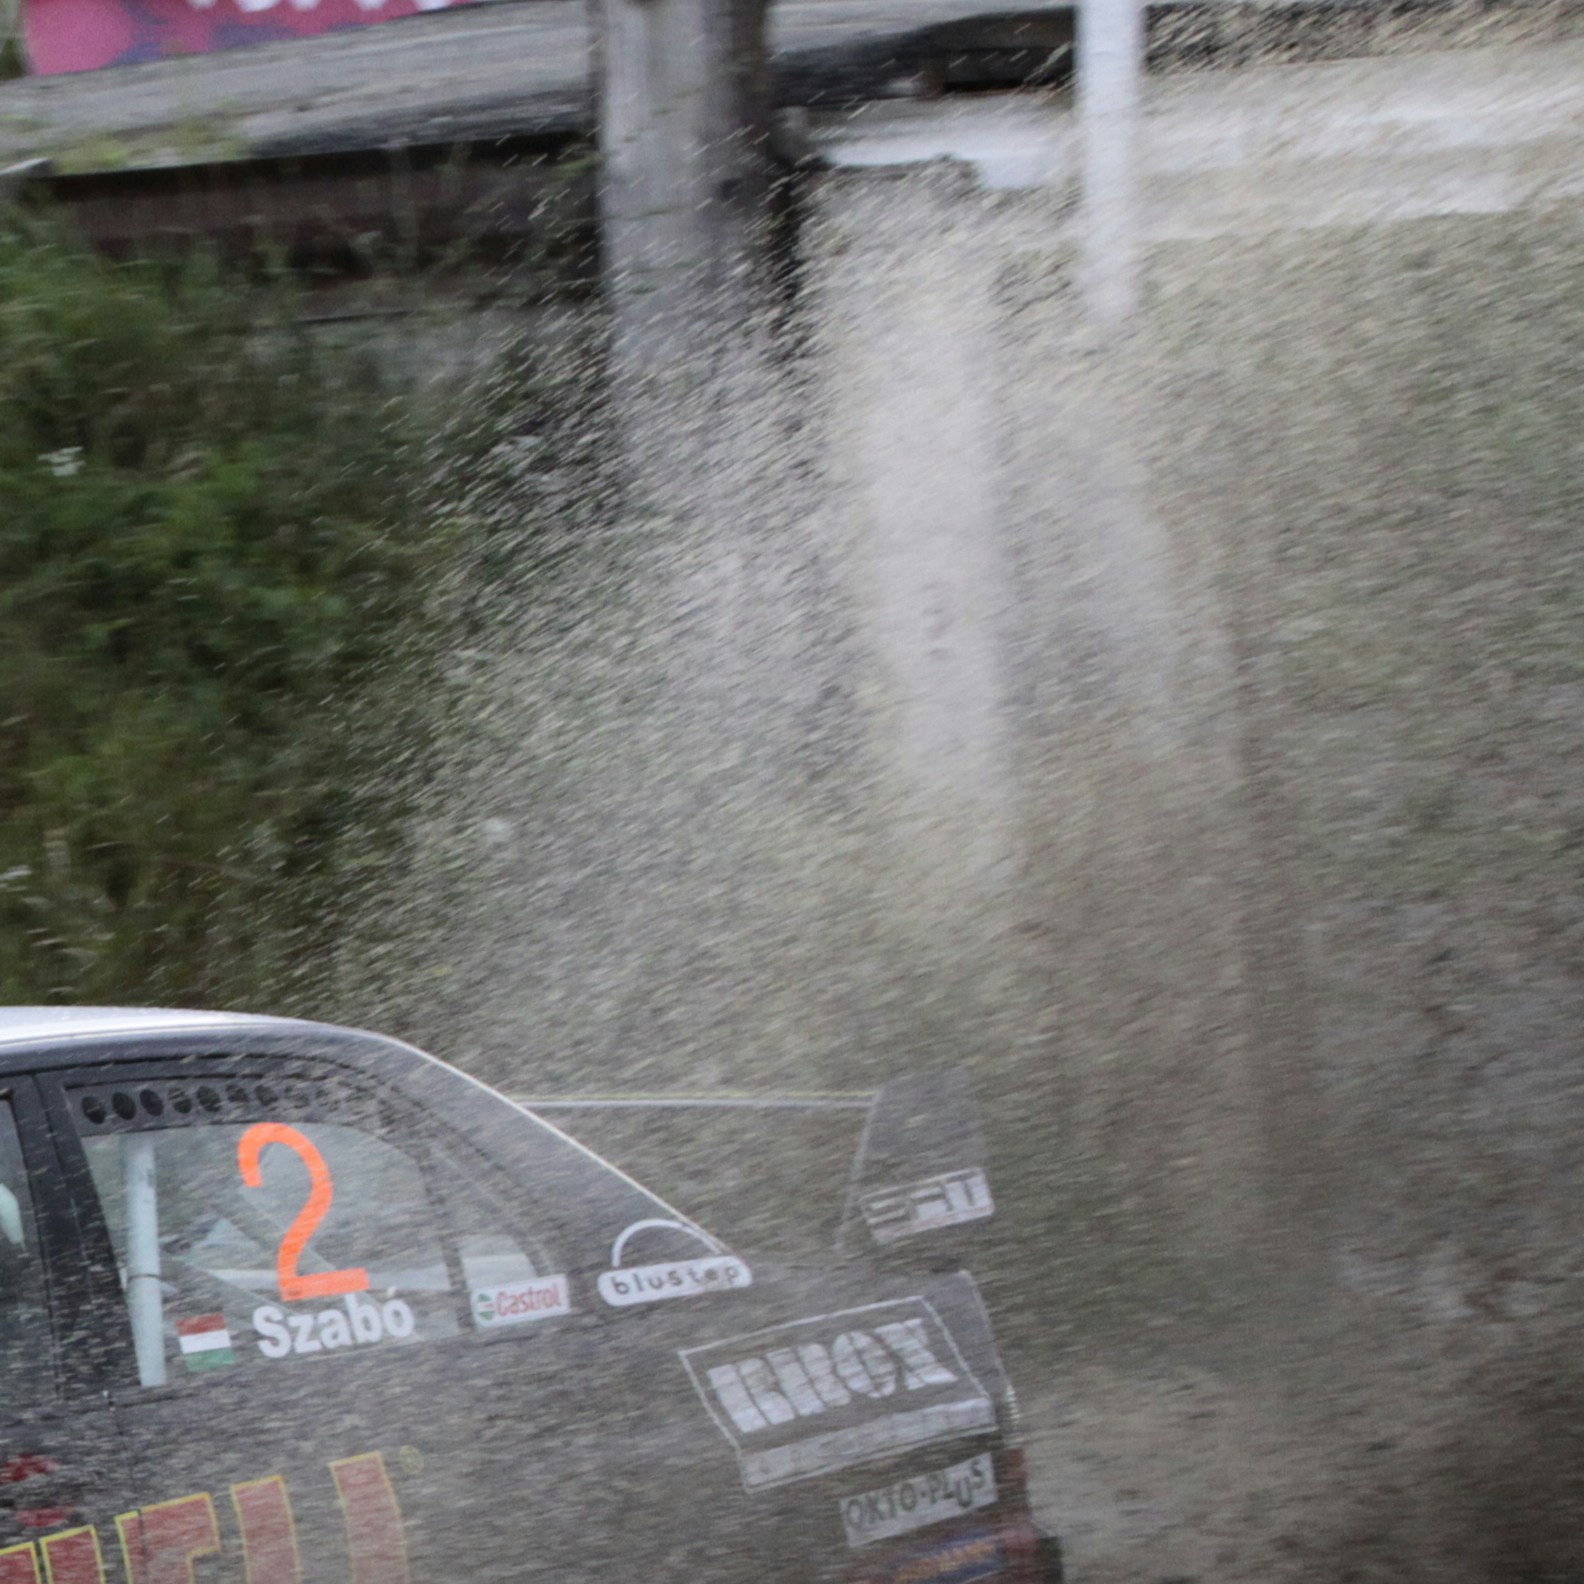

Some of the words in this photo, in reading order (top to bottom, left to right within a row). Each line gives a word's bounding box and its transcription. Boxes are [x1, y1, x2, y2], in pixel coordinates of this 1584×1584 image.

[237, 1122, 370, 1302] 2
[252, 1286, 415, 1359] Szabó
[496, 1285, 561, 1317] Castrol
